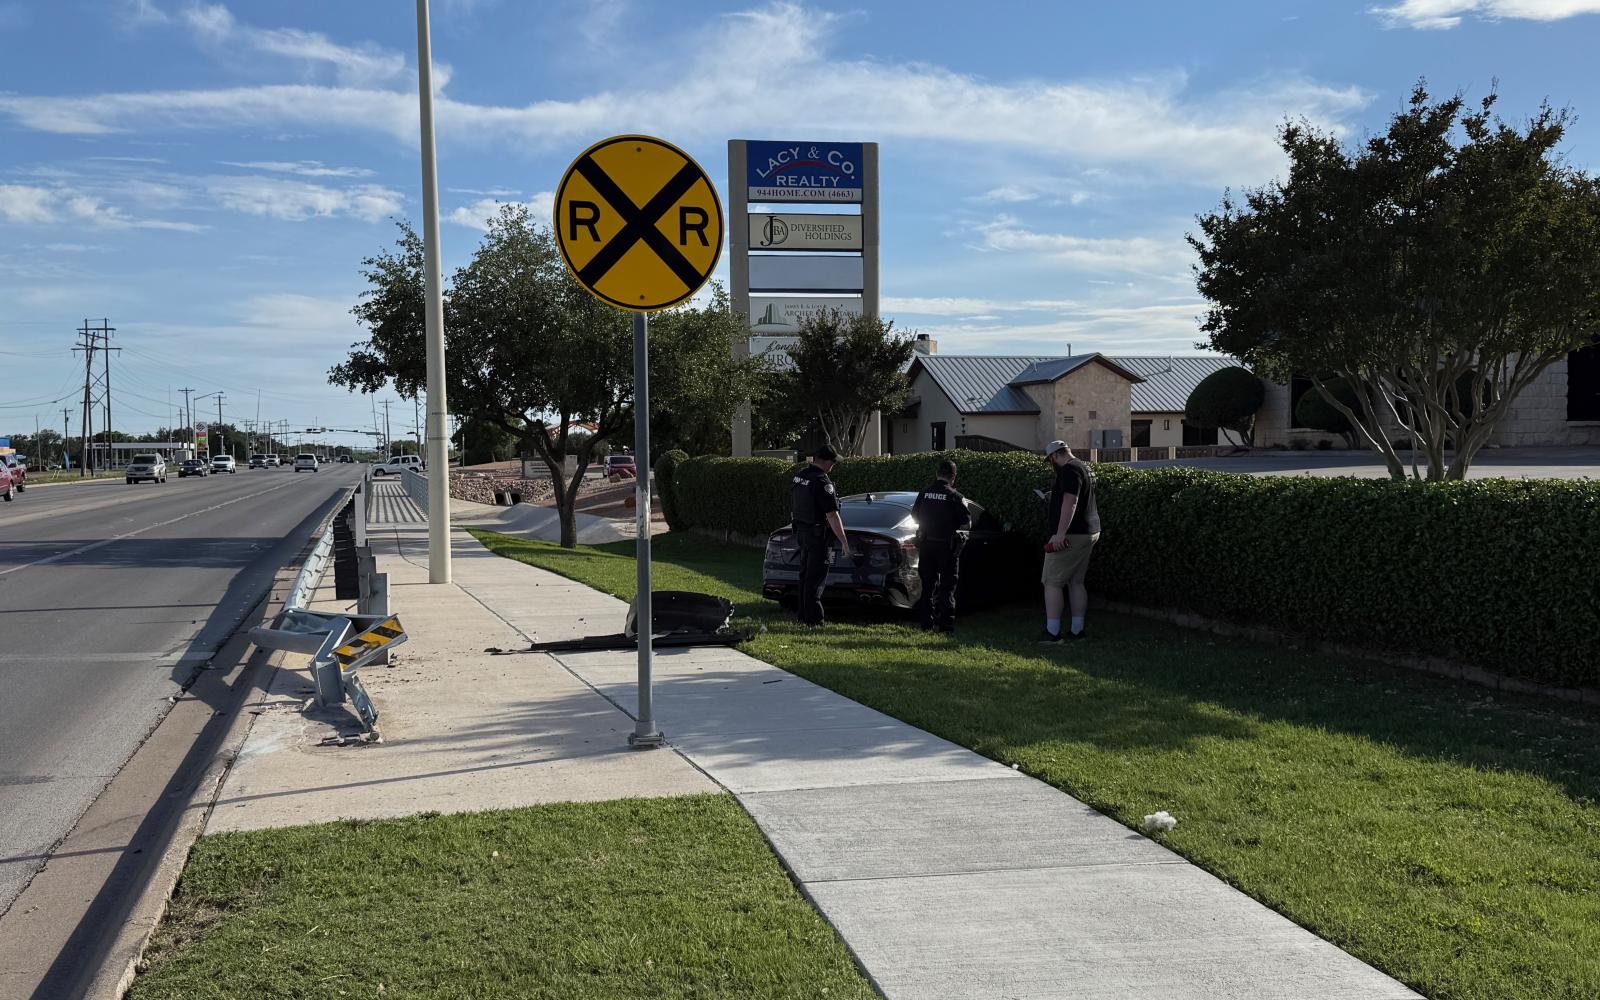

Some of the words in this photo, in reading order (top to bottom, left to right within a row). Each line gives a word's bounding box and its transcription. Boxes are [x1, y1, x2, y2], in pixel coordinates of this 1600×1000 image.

[756, 146, 800, 178] LACY
[807, 146, 820, 159] &
[776, 175, 840, 187] REALTY
[756, 189, 826, 197] 944HOME.COM
[828, 190, 854, 199] (4663)
[568, 200, 601, 242] R
[679, 205, 710, 247] R
[790, 223, 845, 233] DIVERSIFIED
[804, 232, 852, 241] HOLDINGS
[924, 492, 947, 500] POLICE
